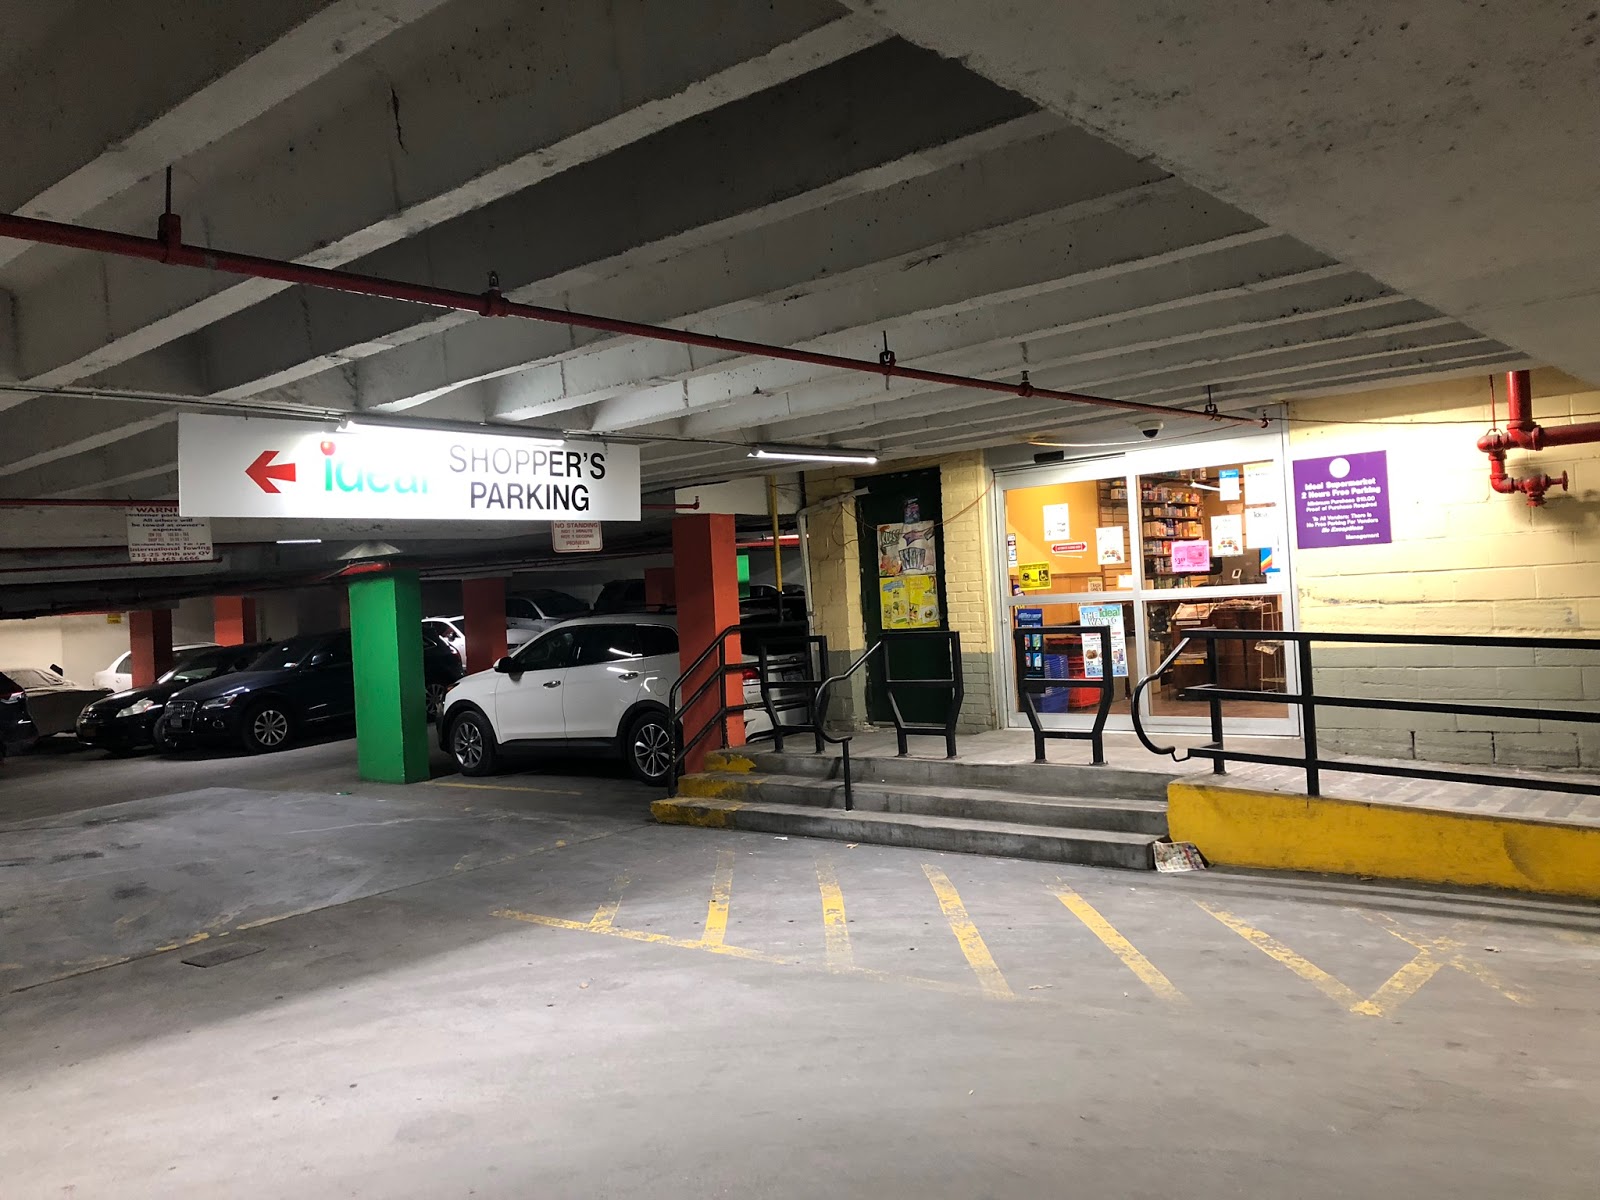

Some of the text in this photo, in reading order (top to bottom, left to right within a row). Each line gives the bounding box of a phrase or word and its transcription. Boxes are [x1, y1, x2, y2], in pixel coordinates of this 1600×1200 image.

[449, 444, 606, 480] SHOPPER'S
[1304, 477, 1376, 491] Ideal Supermarket
[470, 481, 590, 511] PARKING
[1308, 490, 1331, 499] Hours
[1332, 489, 1350, 497] Free
[1351, 486, 1381, 495] Parking
[1098, 607, 1120, 618] ideal
